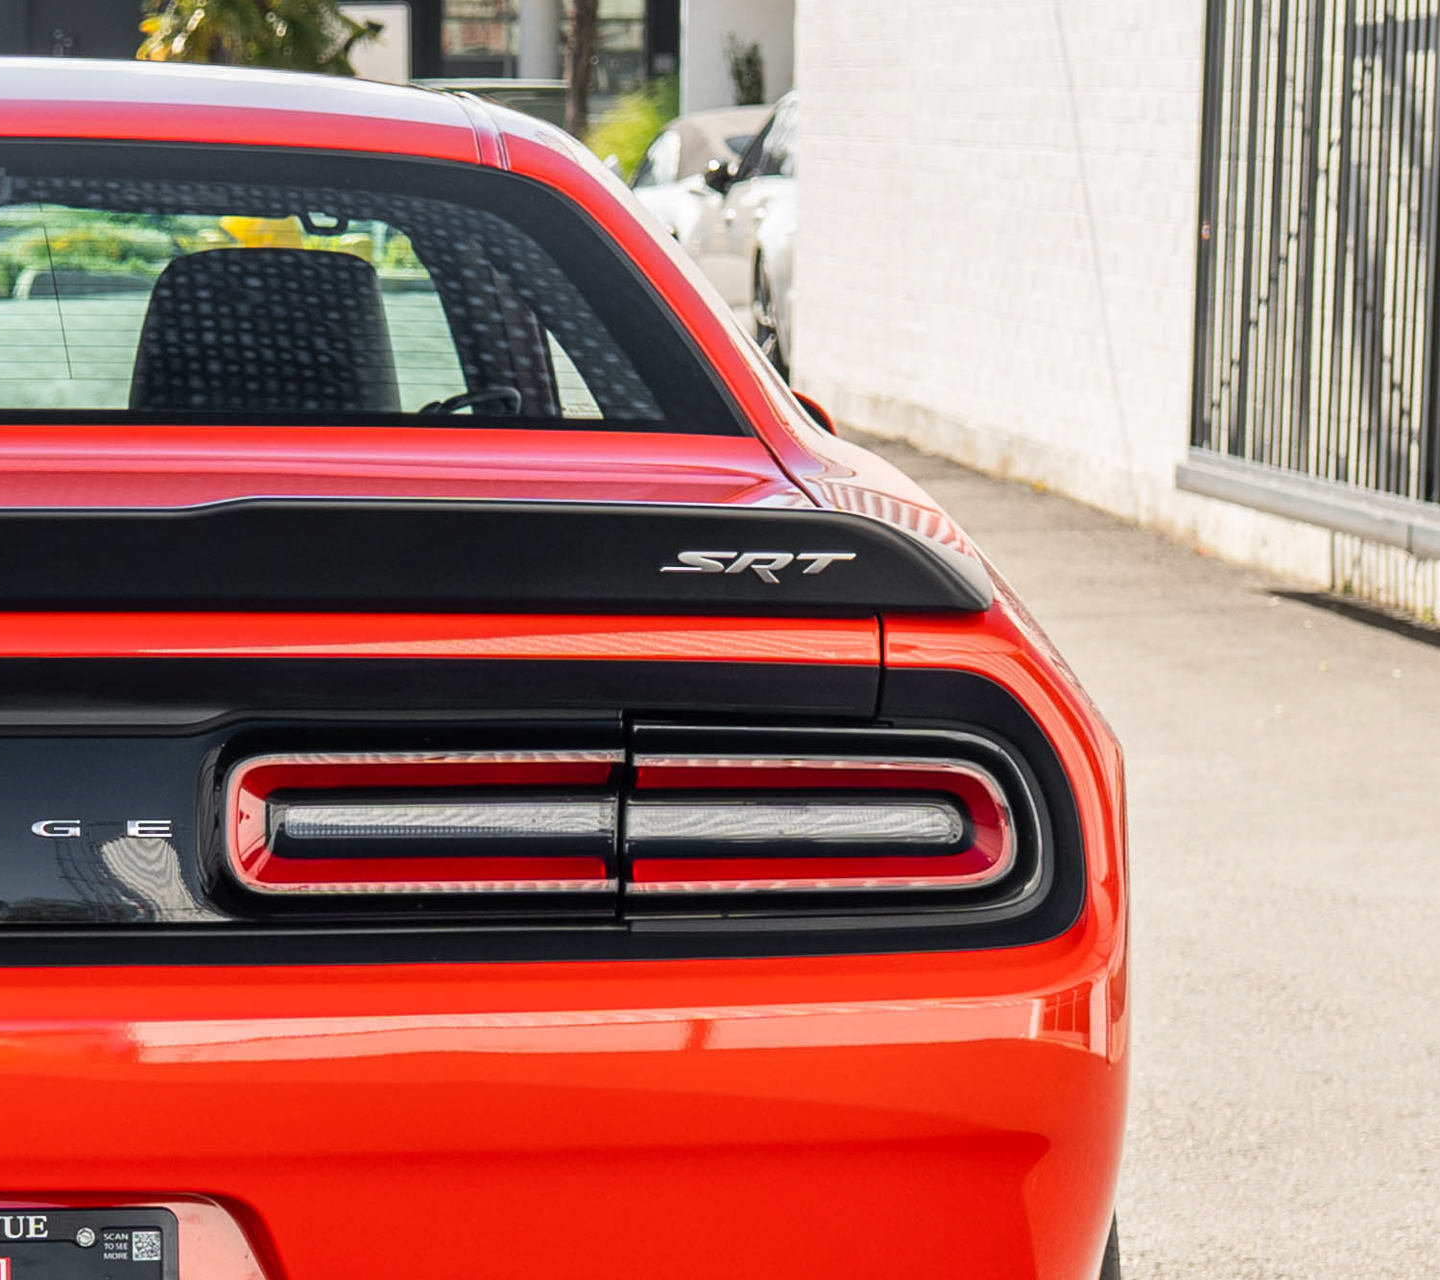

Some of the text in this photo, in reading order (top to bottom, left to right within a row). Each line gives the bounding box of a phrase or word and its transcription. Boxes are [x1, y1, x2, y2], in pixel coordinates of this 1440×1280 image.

[659, 550, 858, 584] SRT
[103, 1232, 129, 1241] SCAN
[103, 1252, 129, 1260] MORE
